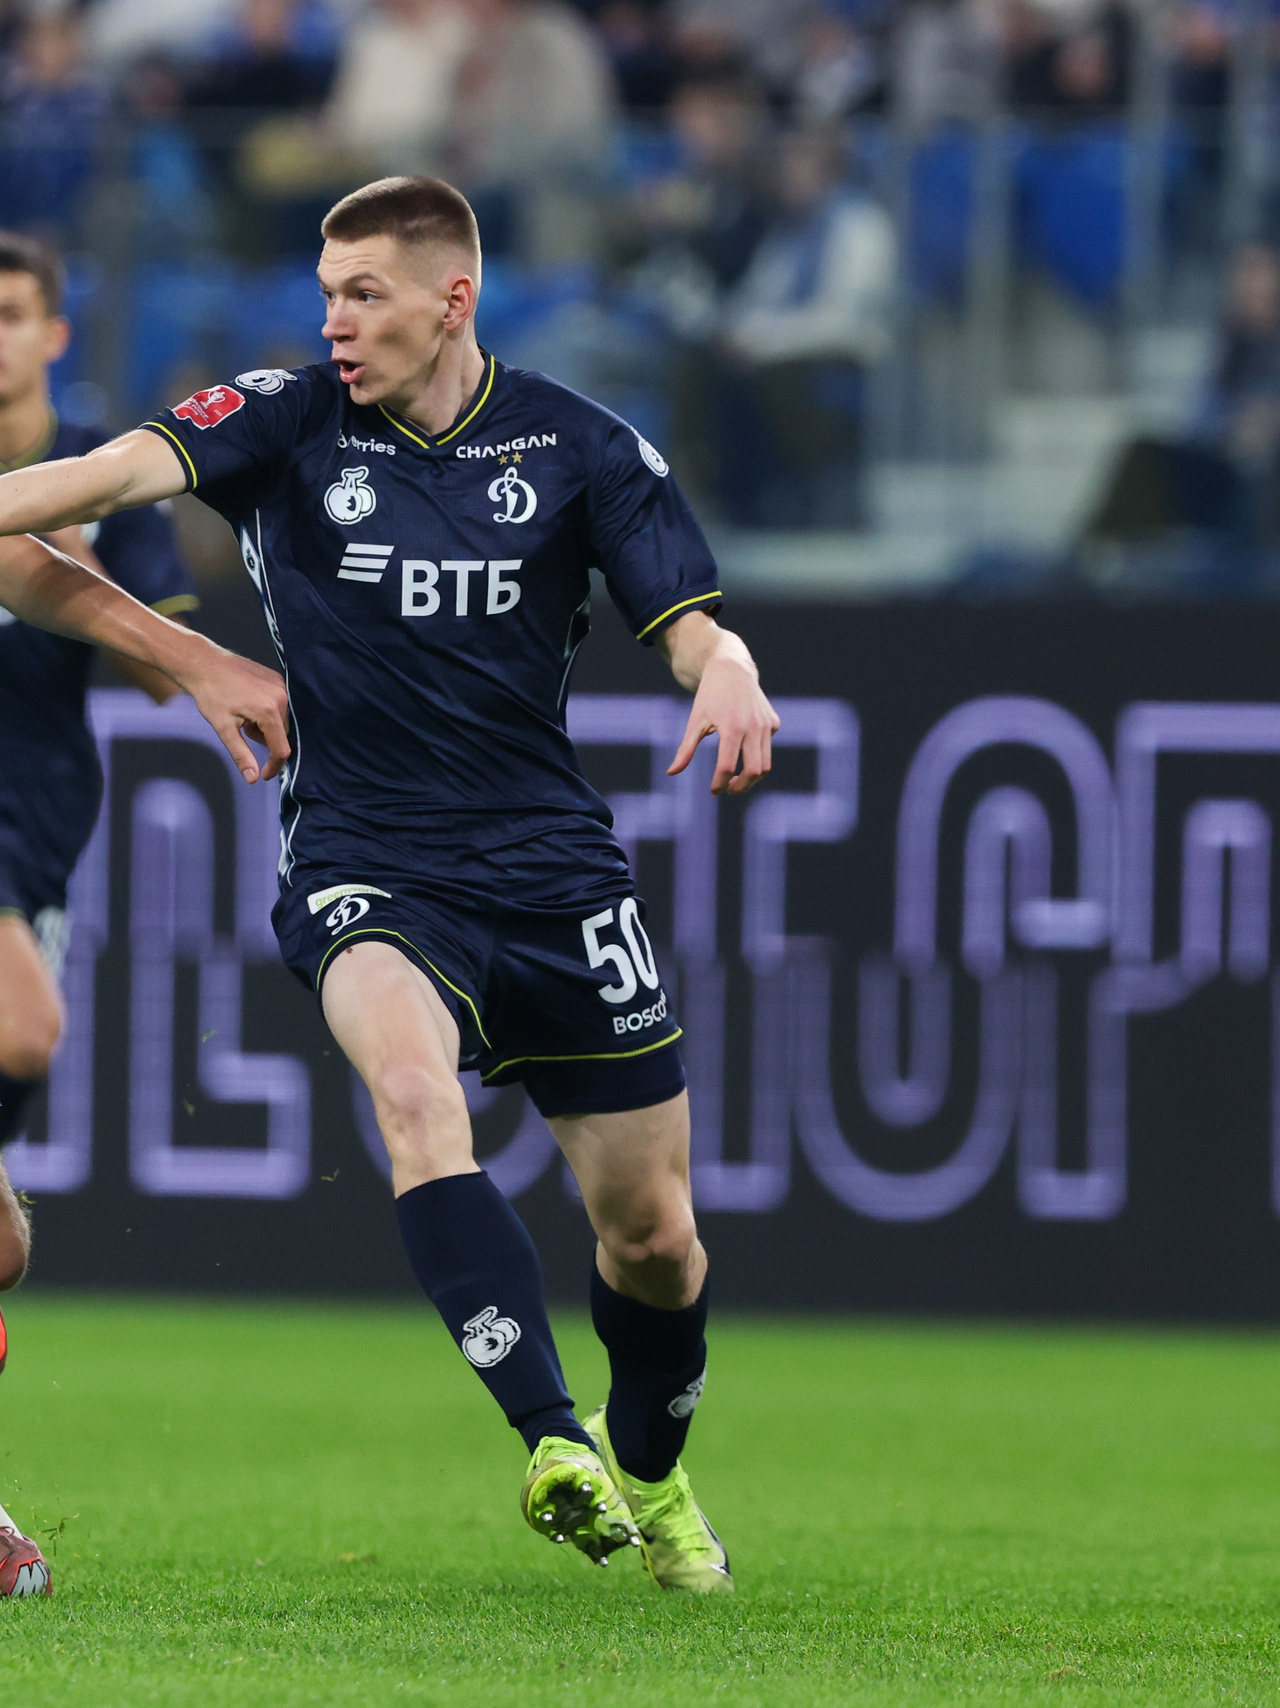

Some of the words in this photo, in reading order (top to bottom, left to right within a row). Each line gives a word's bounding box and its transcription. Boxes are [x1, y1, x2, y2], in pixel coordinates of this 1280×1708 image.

[456, 433, 557, 459] CHANGAN
[401, 559, 523, 617] ВТБ
[315, 887, 386, 909] greenworks
[581, 897, 659, 1004] 50
[613, 1000, 667, 1035] BOSCO
